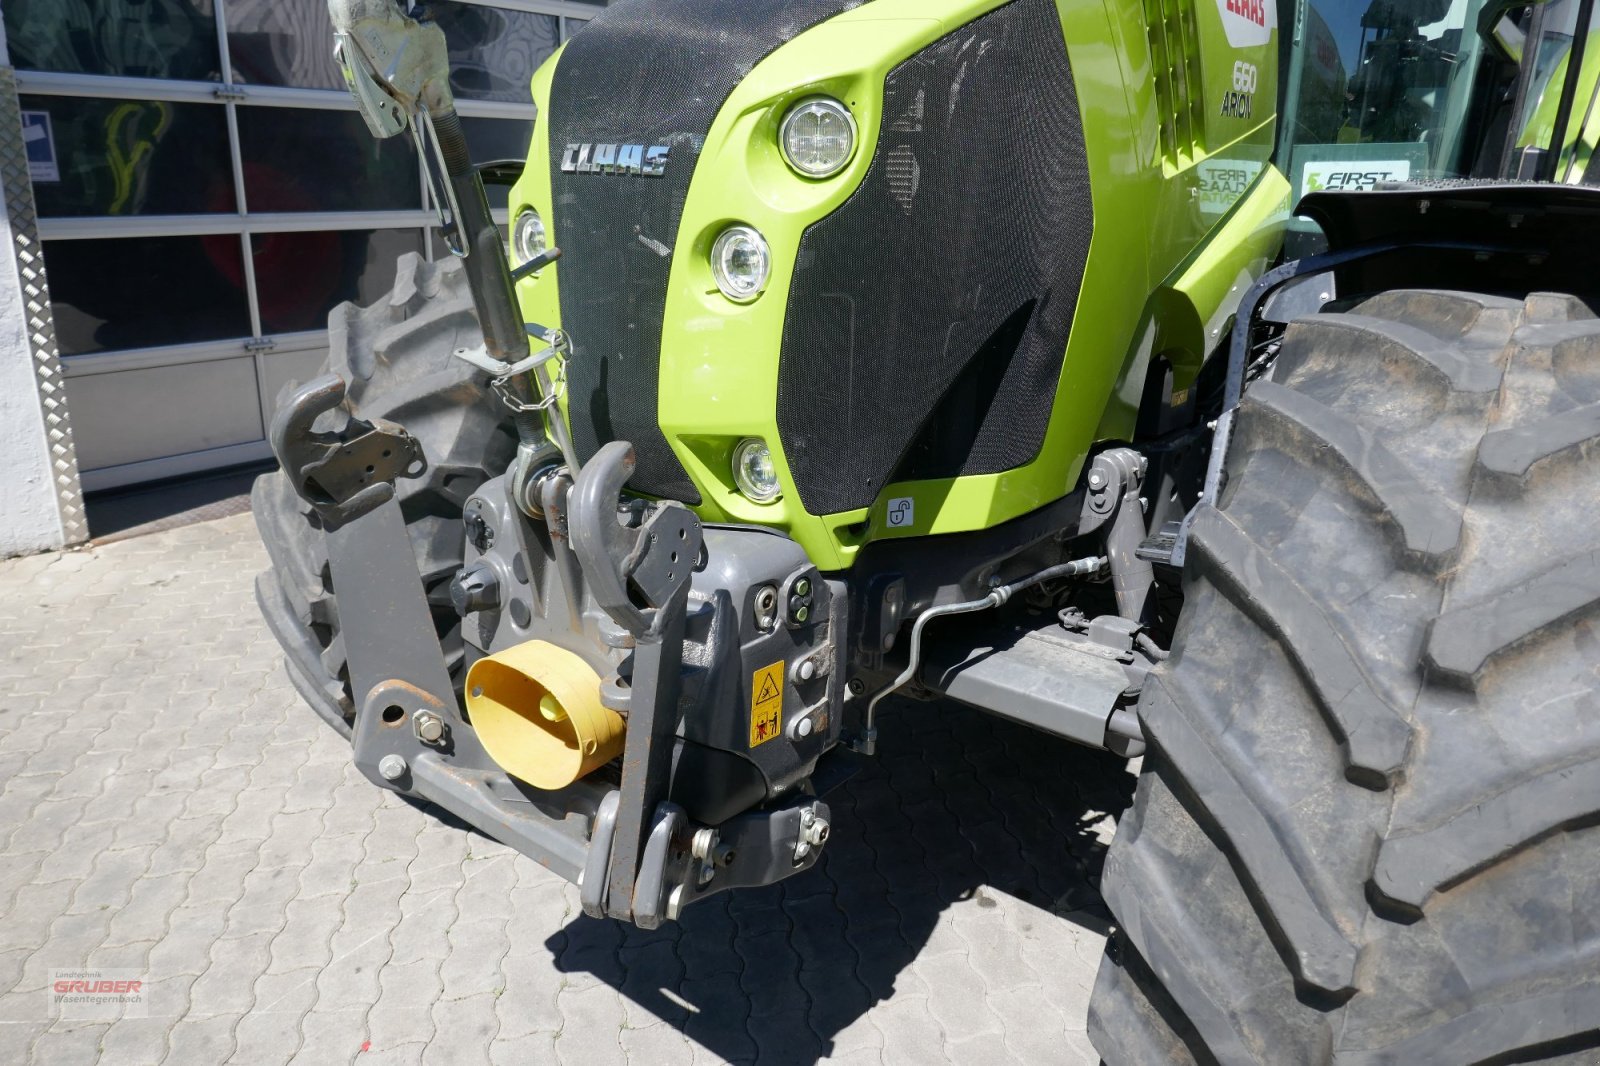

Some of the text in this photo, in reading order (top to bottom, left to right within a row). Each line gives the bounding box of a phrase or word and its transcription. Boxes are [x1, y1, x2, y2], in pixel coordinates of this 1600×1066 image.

[1220, 91, 1252, 119] ARION
[561, 143, 670, 175] CLAAS
[1326, 172, 1393, 185] FIRST
